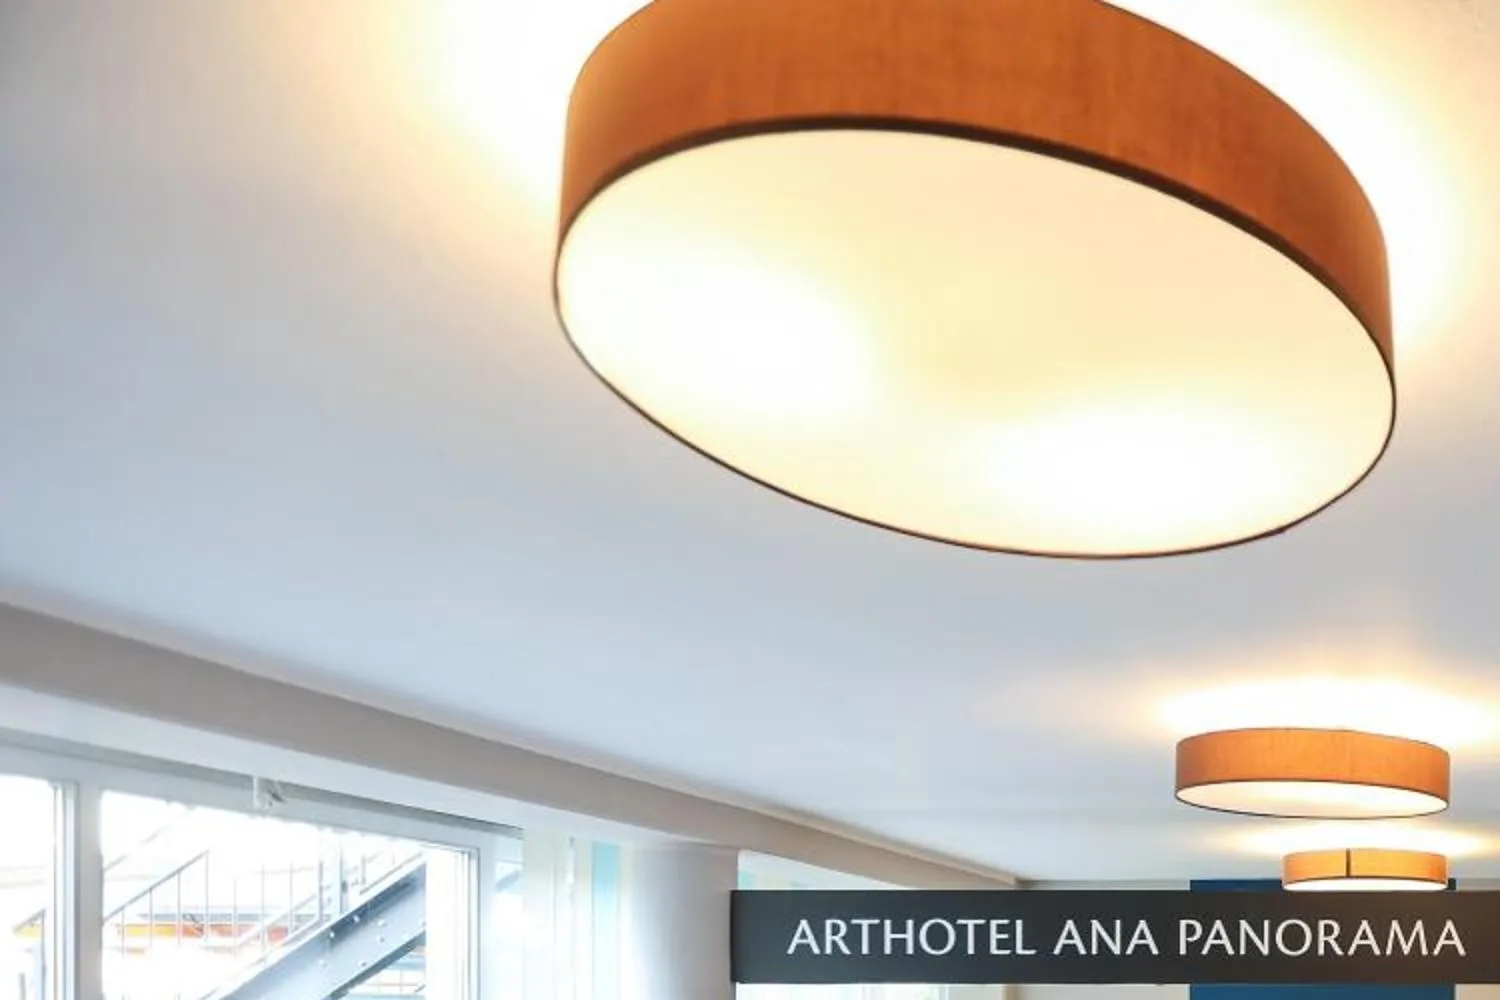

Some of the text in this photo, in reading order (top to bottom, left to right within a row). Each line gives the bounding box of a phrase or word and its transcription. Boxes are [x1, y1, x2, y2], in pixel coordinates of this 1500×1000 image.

[785, 917, 1467, 956] ARTHOTEL ANA PANORAMA
